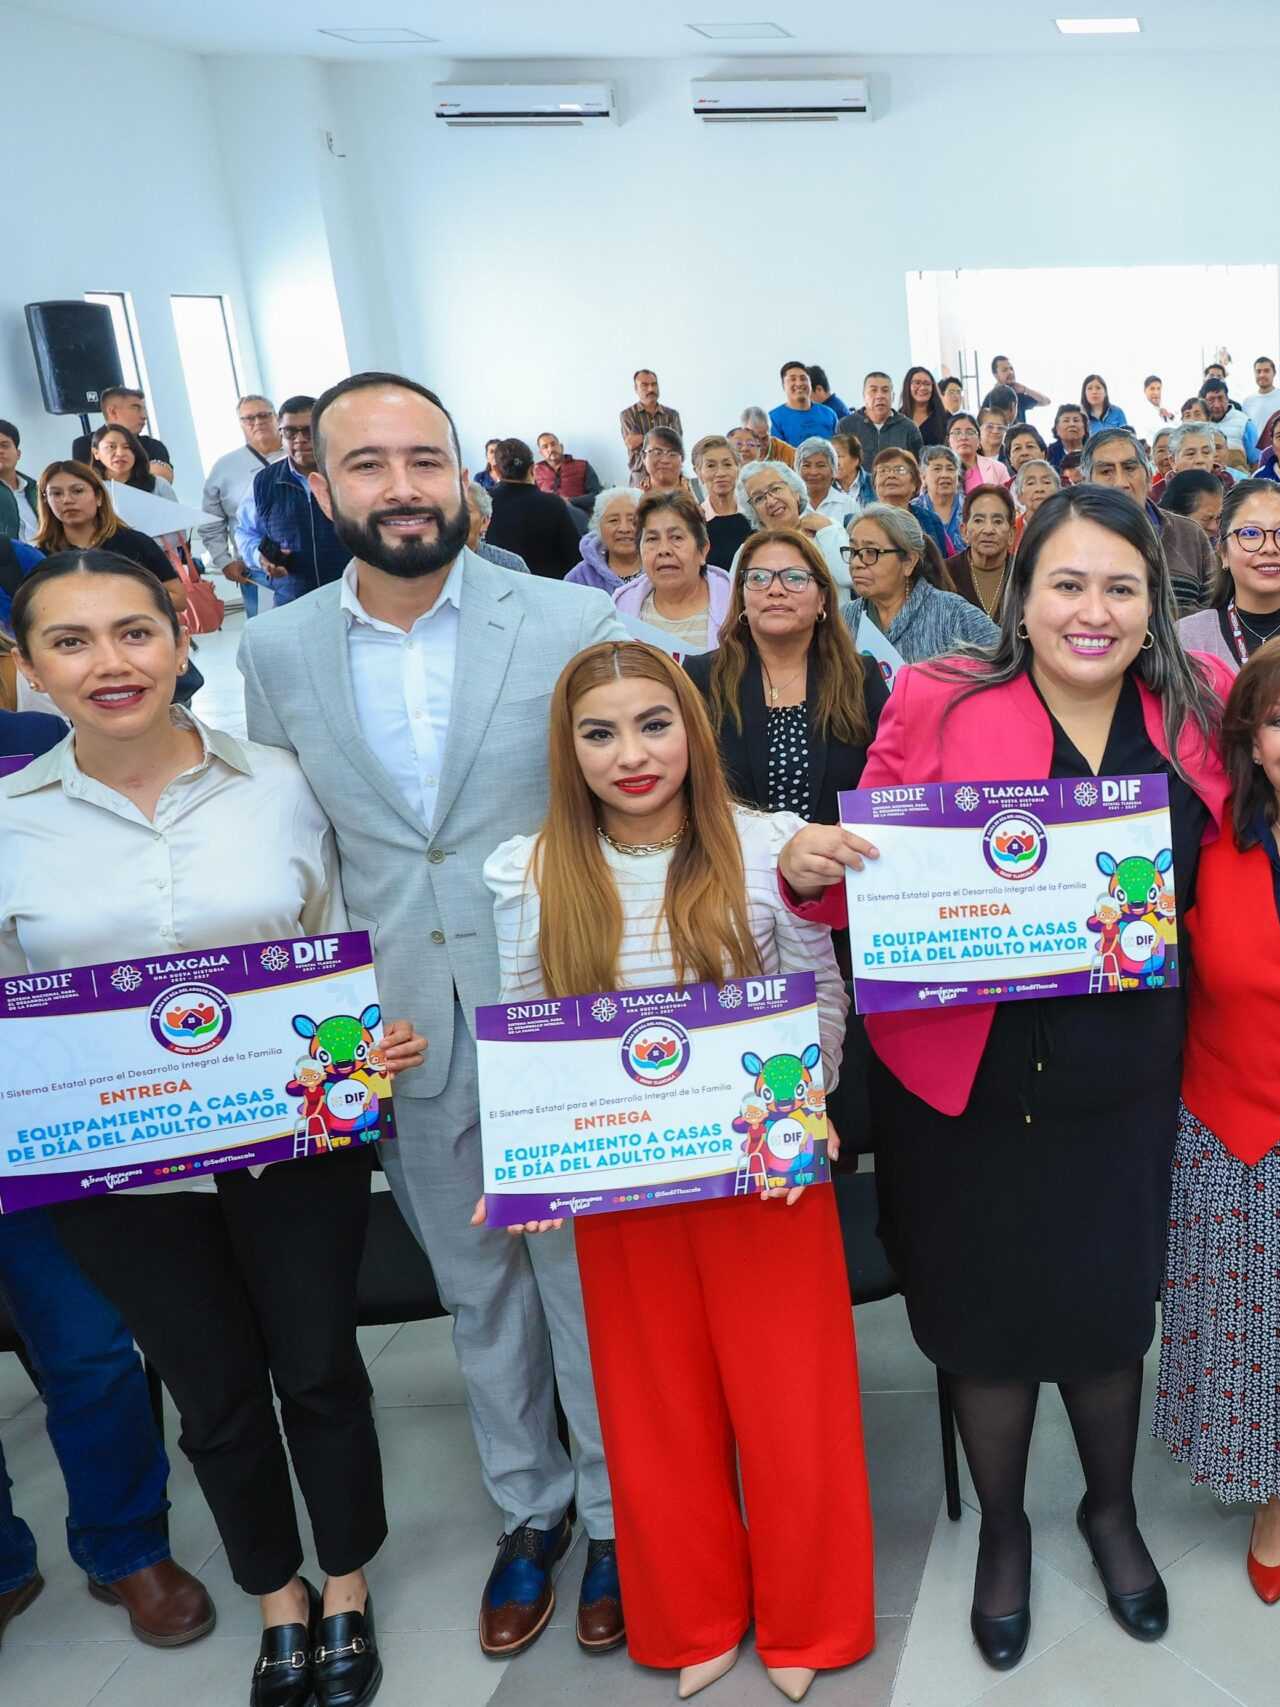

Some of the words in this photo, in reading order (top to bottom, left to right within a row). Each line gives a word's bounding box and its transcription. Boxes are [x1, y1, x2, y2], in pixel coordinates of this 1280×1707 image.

[870, 787, 925, 803] SNDIF
[981, 784, 1049, 798] TLAXCALA
[1101, 778, 1141, 801] DIF
[938, 902, 1011, 919] ENTREGA
[873, 925, 1002, 948] EQUIPAMIENTO
[1006, 925, 1018, 937] A
[1021, 920, 1077, 936] CASAS
[1136, 934, 1153, 945] DIF
[291, 936, 340, 964] DIF
[863, 951, 885, 965] DE
[890, 944, 922, 963] DÍA
[926, 946, 956, 961] DEL
[959, 941, 1025, 958] ADULTO
[1029, 936, 1087, 953] MAYOR
[144, 953, 229, 975] TLAXCALA
[3, 972, 73, 995] SNDIF
[745, 977, 787, 1002] DIF
[620, 989, 691, 1008] TLAXCALA
[506, 1002, 561, 1020] SNDIF
[5, 1083, 49, 1099] Sistema
[50, 1077, 87, 1091] Estatal
[88, 1074, 114, 1086] para
[115, 1071, 125, 1079] el
[127, 1062, 179, 1079] Desarrollo
[181, 1055, 220, 1071] Integral
[221, 1053, 234, 1063] de
[235, 1051, 247, 1061] la
[247, 1046, 282, 1059] Familia
[99, 1077, 192, 1105] ENTREGA
[344, 1091, 365, 1103] DIF
[499, 1105, 534, 1118] Sistema
[535, 1101, 565, 1113] Estatal
[566, 1100, 587, 1111] para
[599, 1092, 642, 1106] Desarrollo
[644, 1088, 677, 1102] Integral
[701, 1082, 731, 1093] Familia
[16, 1102, 182, 1144] EQUIPAMIENTO
[186, 1099, 202, 1114] A
[206, 1087, 274, 1110] CASAS
[574, 1108, 651, 1130] ENTREGA
[6, 1145, 35, 1163] DE
[40, 1133, 82, 1157] DÍA
[86, 1129, 125, 1149] DEL
[129, 1114, 212, 1141] ADULTO
[217, 1101, 288, 1126] MAYOR
[504, 1131, 641, 1163] EQUIPAMIENTO
[646, 1131, 658, 1144] A
[663, 1122, 722, 1142] CASAS
[783, 1131, 802, 1143] DIF
[494, 1165, 517, 1181] DE
[521, 1156, 555, 1177] DÍA
[560, 1155, 591, 1172] DEL
[595, 1145, 665, 1168] ADULTO
[671, 1137, 732, 1158] MAYOR
